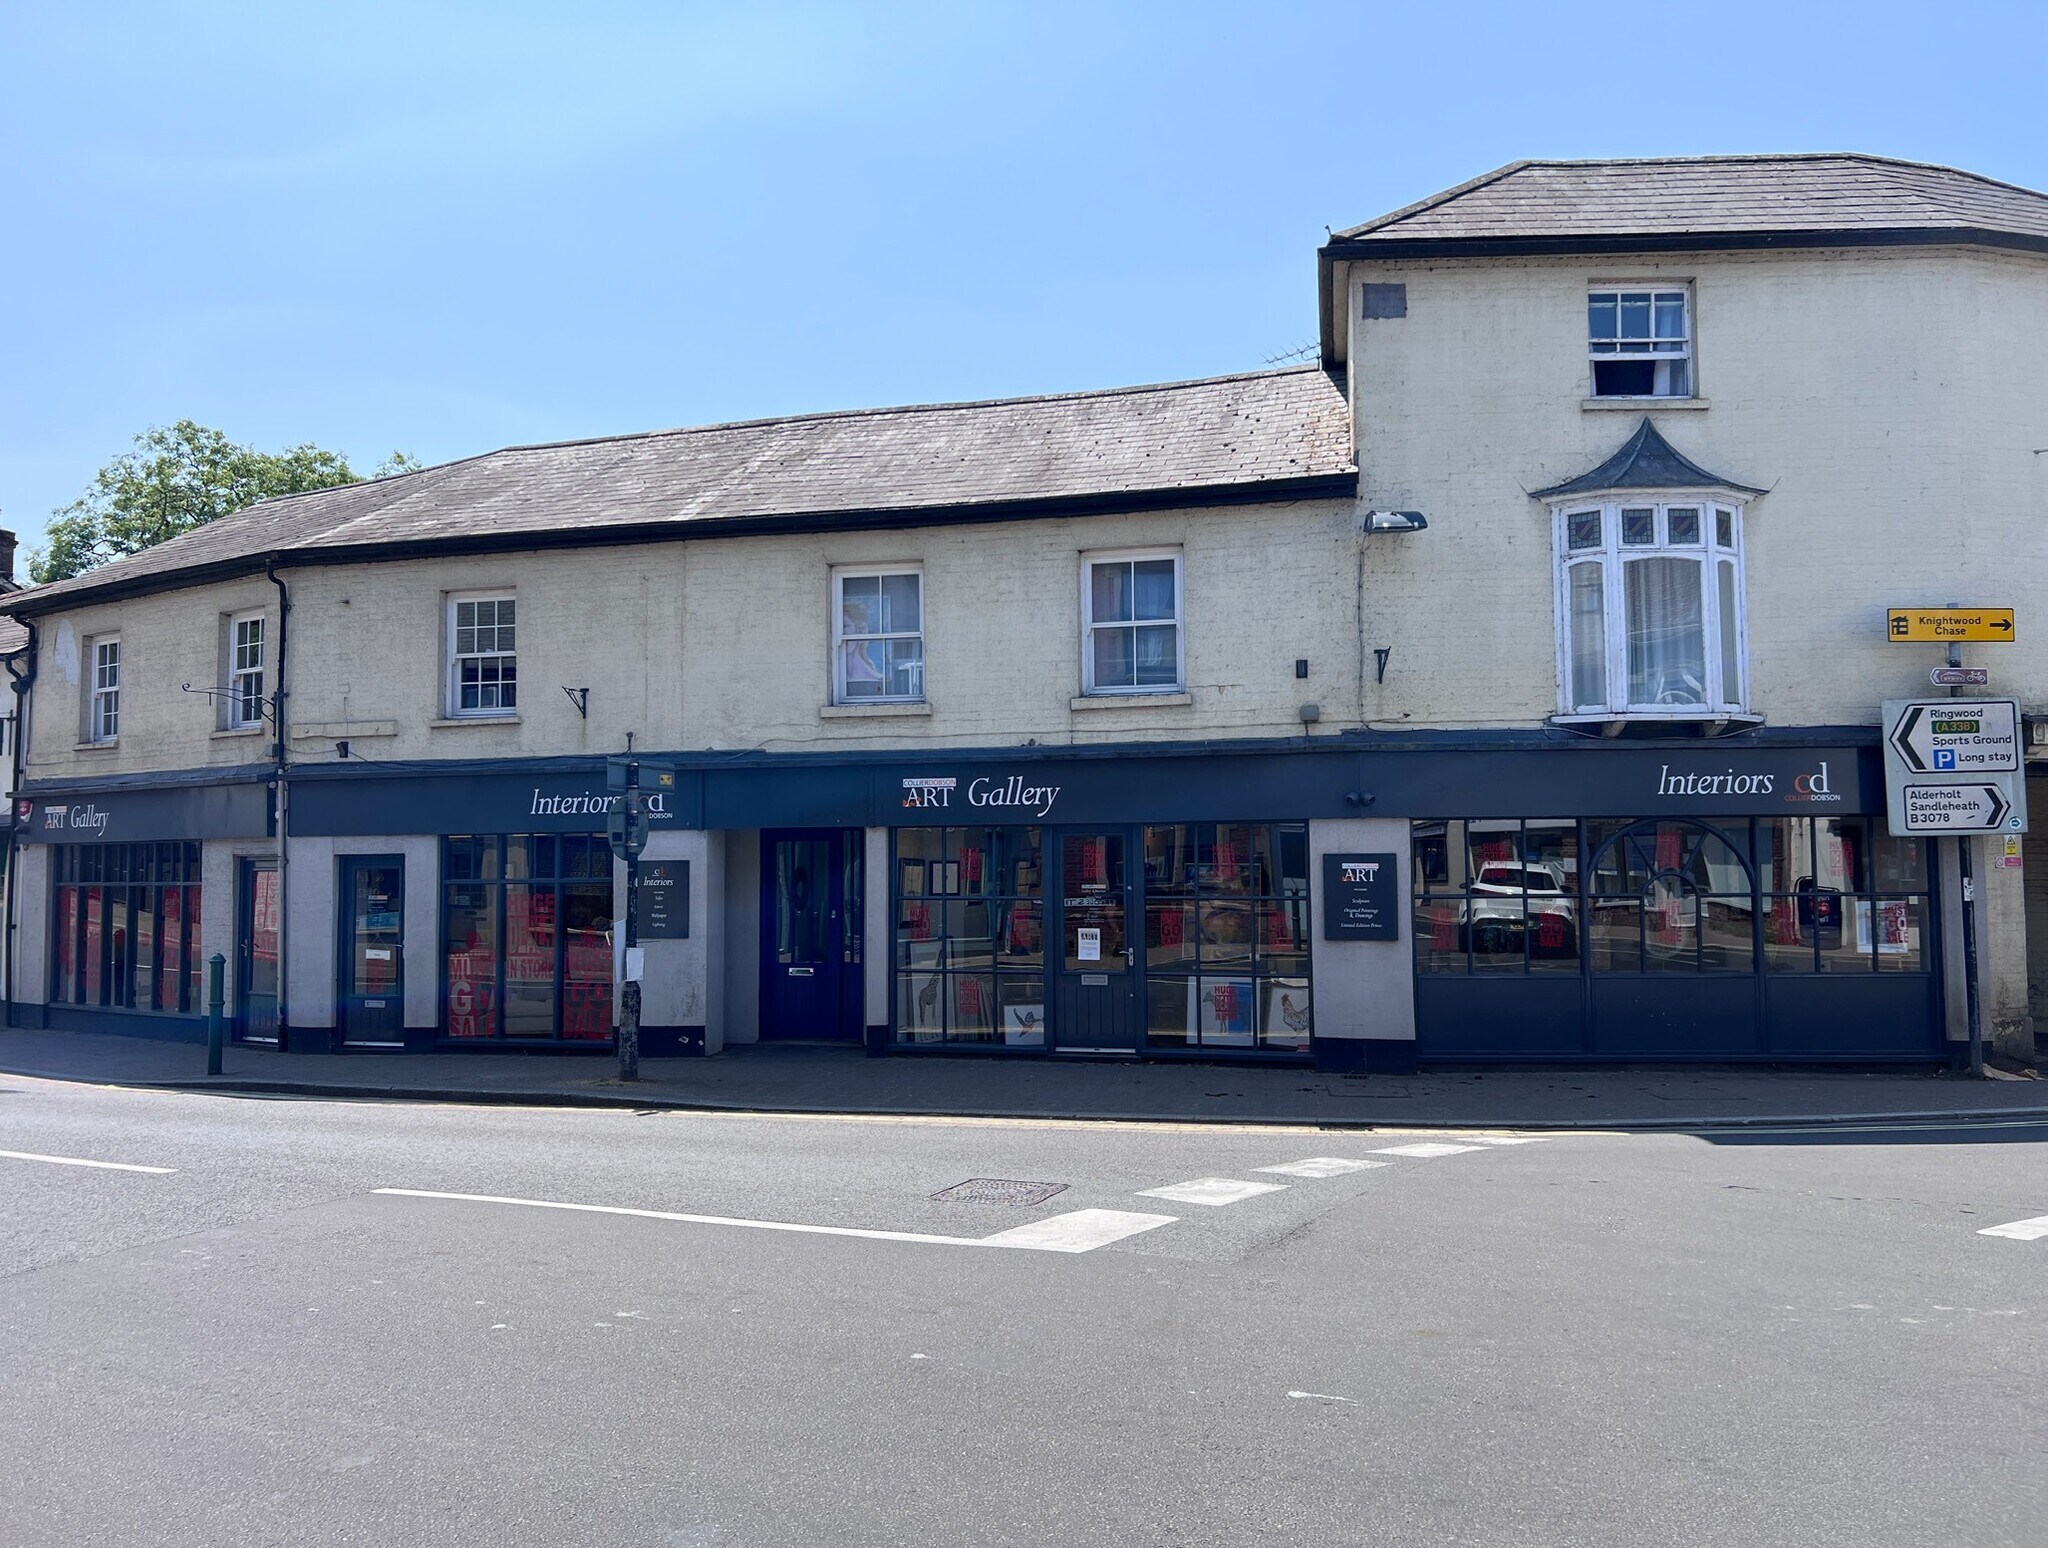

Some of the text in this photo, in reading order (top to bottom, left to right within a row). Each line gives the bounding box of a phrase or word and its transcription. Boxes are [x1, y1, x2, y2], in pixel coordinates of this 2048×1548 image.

[1919, 616, 1981, 626] Knightwood
[1935, 626, 1966, 636] Chase
[1930, 709, 1983, 718] Ringwood
[1933, 735, 2012, 746] Sports Ground
[1938, 750, 1952, 768] P
[1959, 752, 2012, 764] Long stay
[1657, 764, 1774, 795] Interiors
[902, 776, 1061, 818] ART Gallery
[1910, 790, 1961, 800] Alderholt
[1910, 801, 1980, 812] Sandleheath
[45, 804, 110, 837] ART Gallery
[643, 876, 674, 886] Interiors
[1342, 869, 1377, 882] ART
